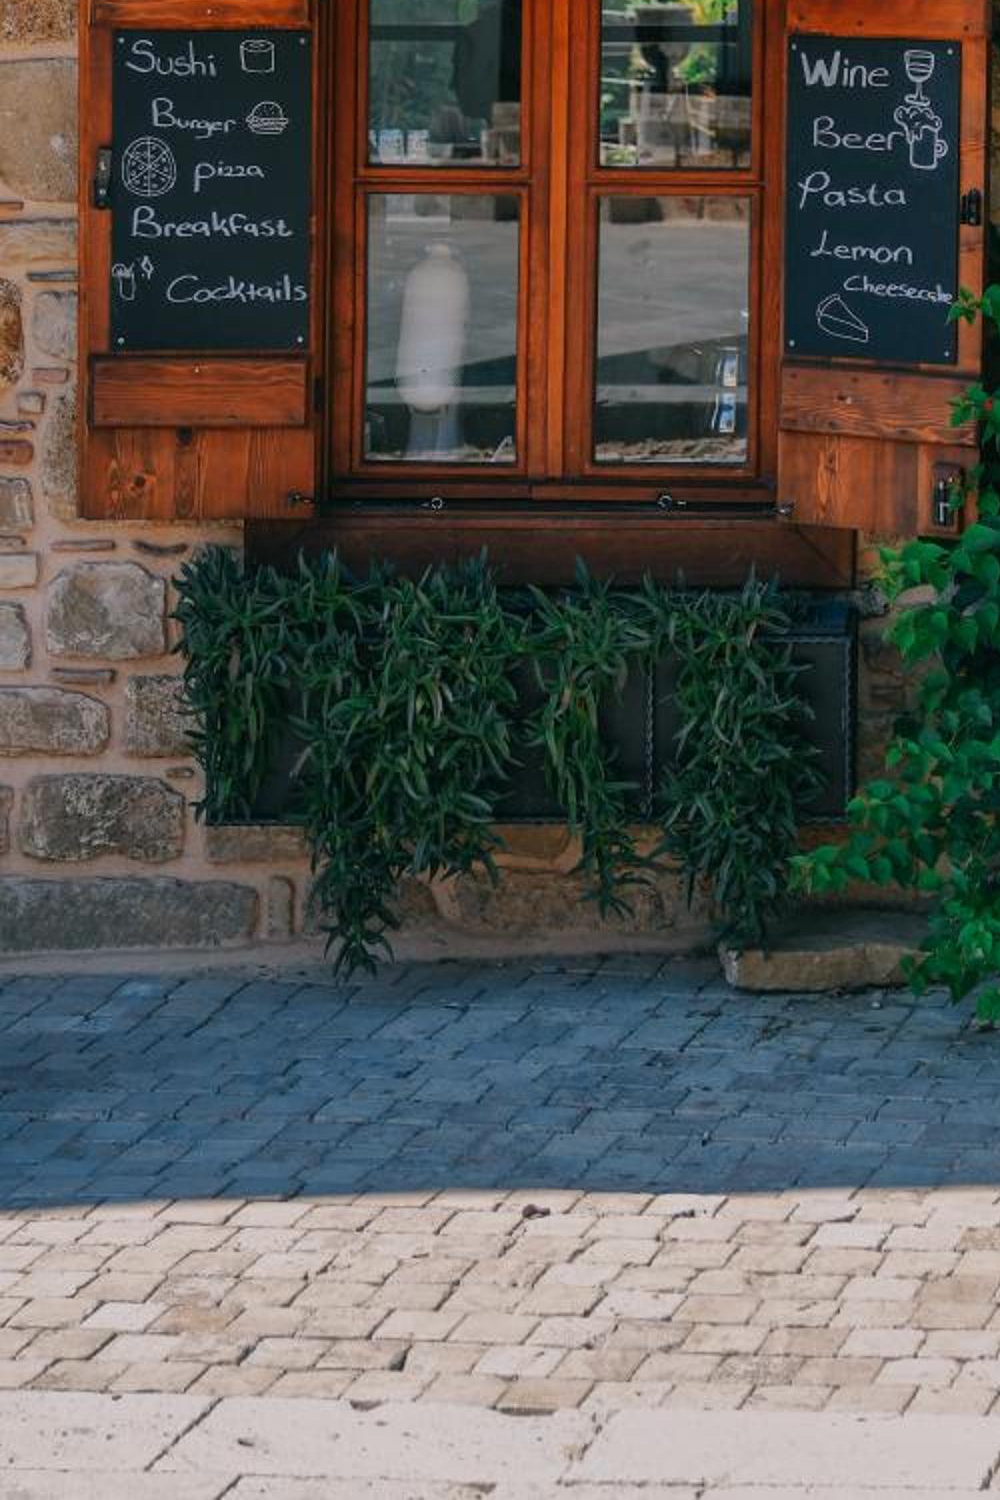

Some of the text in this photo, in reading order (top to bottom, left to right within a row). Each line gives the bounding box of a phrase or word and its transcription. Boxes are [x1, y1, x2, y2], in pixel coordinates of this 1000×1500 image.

[125, 39, 217, 77] Sushi
[801, 50, 890, 88] Wine
[151, 97, 238, 139] Burger
[812, 115, 907, 151] Beer
[192, 161, 266, 193] pizza
[798, 171, 907, 209] Pasta
[130, 205, 293, 238] Breakfast
[810, 229, 913, 265] Lemon
[165, 274, 308, 303] Cocktails
